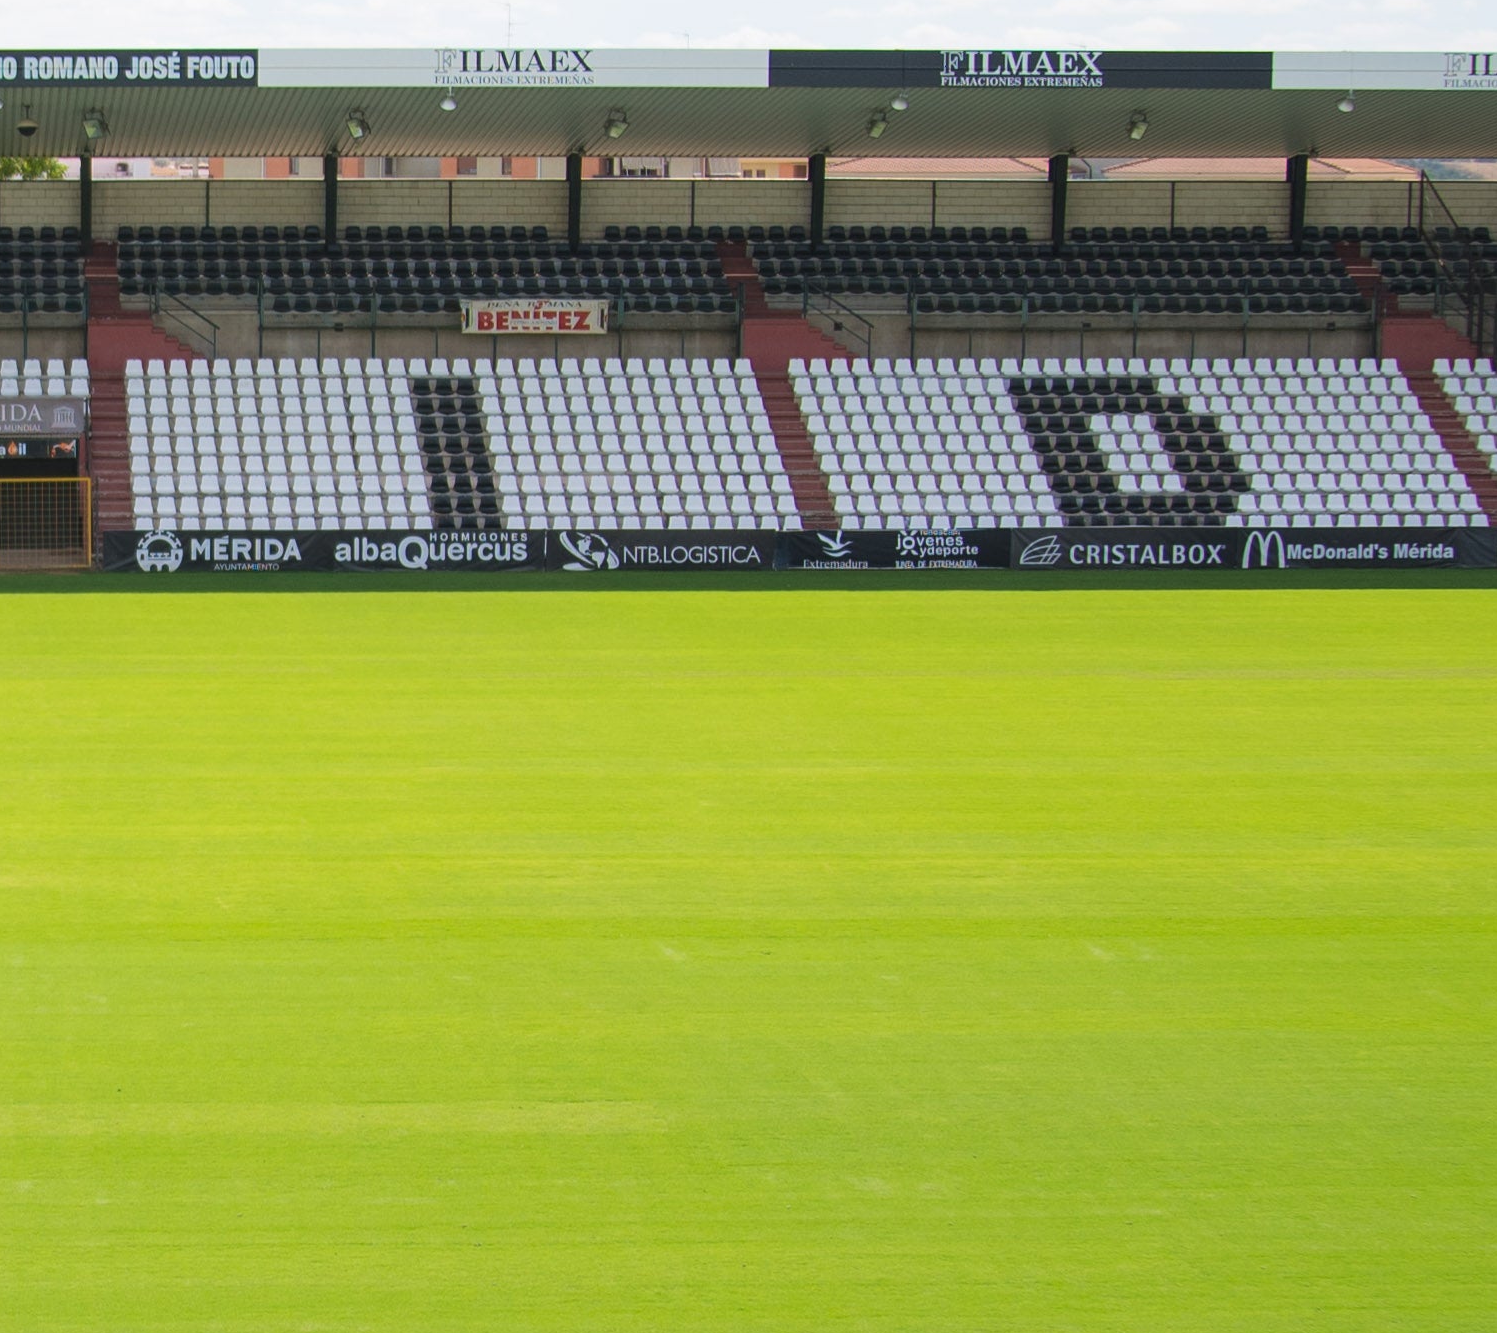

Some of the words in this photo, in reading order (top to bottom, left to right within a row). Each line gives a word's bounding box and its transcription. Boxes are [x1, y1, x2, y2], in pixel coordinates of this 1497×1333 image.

[24, 56, 118, 80] ROMANO
[126, 51, 181, 80] JOSÉ
[187, 55, 254, 80] FOUTO
[434, 49, 594, 73] FILMAEX
[940, 50, 1103, 75] FILMAEX
[434, 75, 514, 85] FILMACIONES
[517, 74, 594, 85] EXTREMEÑAS
[941, 76, 1021, 87] FILMACIONES
[1024, 75, 1103, 87] EXTREMEÑAS
[4, 424, 42, 433] MUNDIAL
[430, 532, 529, 542] HORMIGONES
[191, 535, 302, 561] MÉRIDA
[623, 545, 761, 564] NTB.LOGISTICA
[920, 544, 979, 557] ydeporte
[1069, 544, 1223, 565] CRISTALBOX
[1287, 543, 1389, 560] McDonald's
[1393, 542, 1455, 560] Mérida
[214, 564, 280, 572] AYUNTAMIENTO
[803, 559, 869, 569] Extremadura
